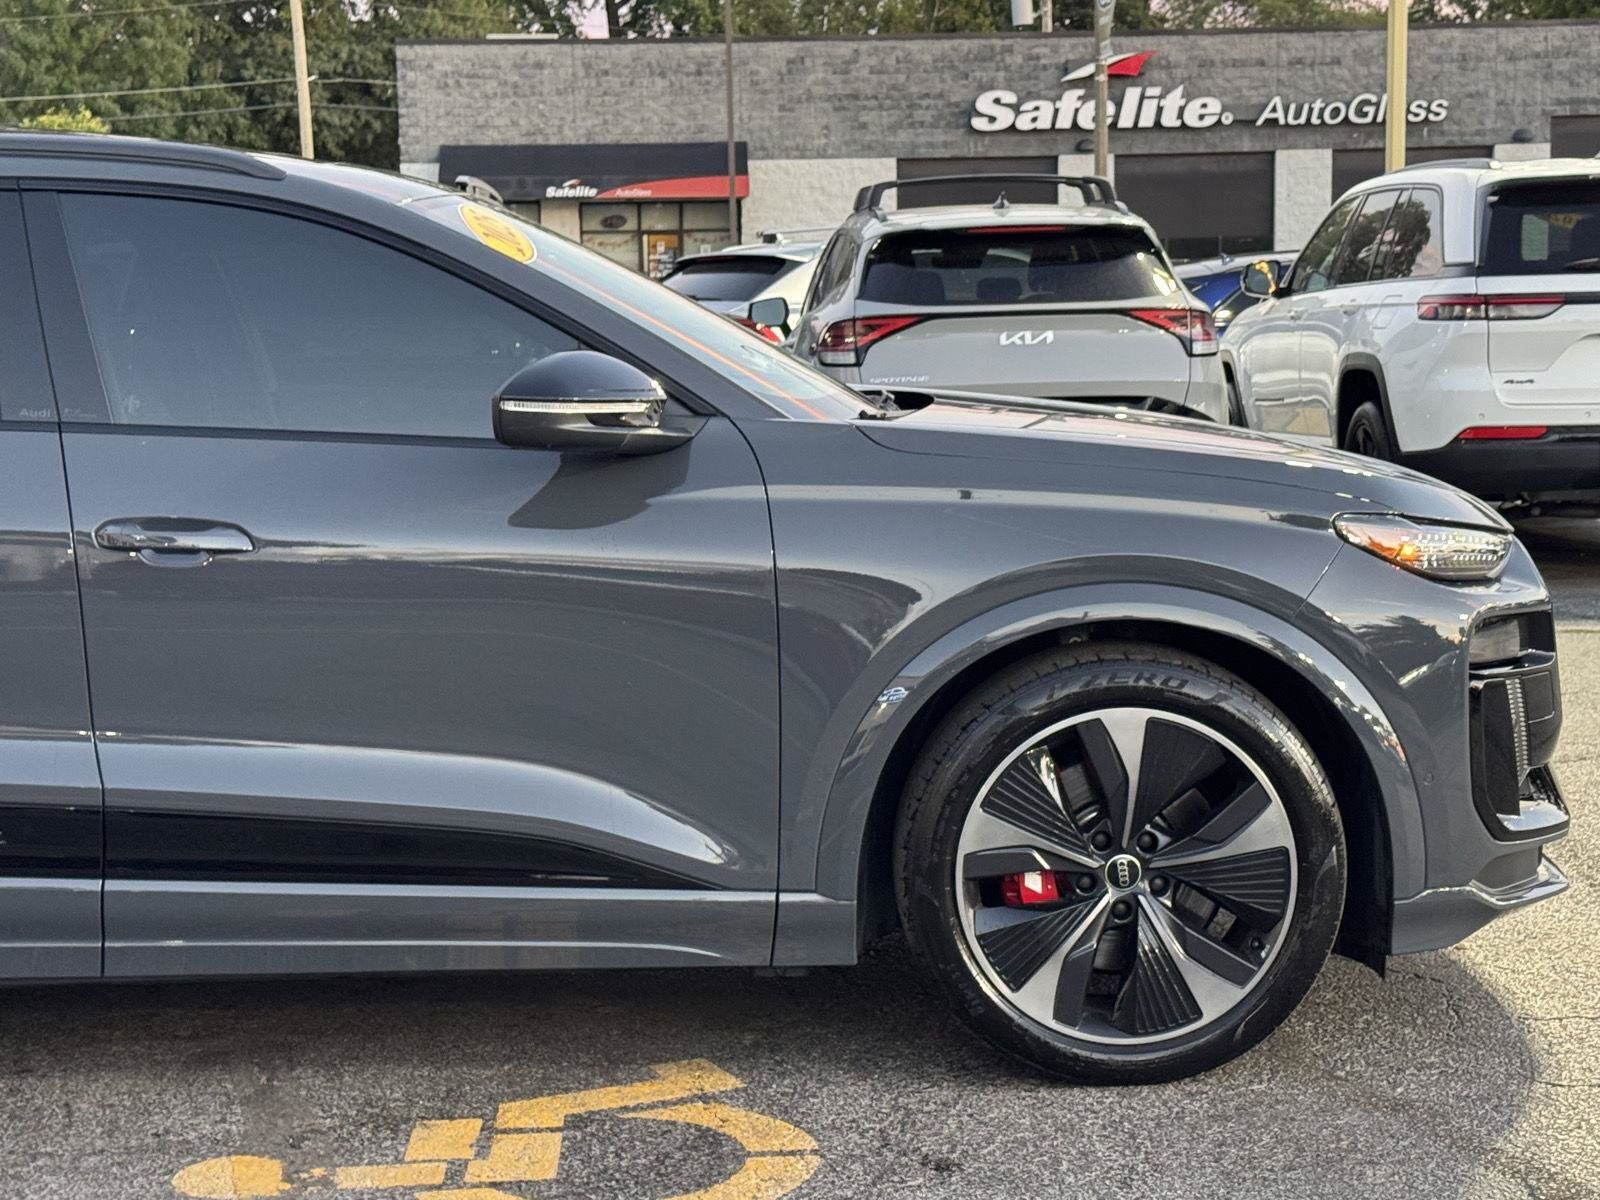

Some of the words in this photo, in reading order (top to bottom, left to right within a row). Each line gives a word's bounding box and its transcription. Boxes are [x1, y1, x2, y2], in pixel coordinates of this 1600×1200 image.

[1255, 93, 1450, 126] AutoGlss
[545, 186, 598, 198] Safelite
[999, 330, 1054, 345] KIA
